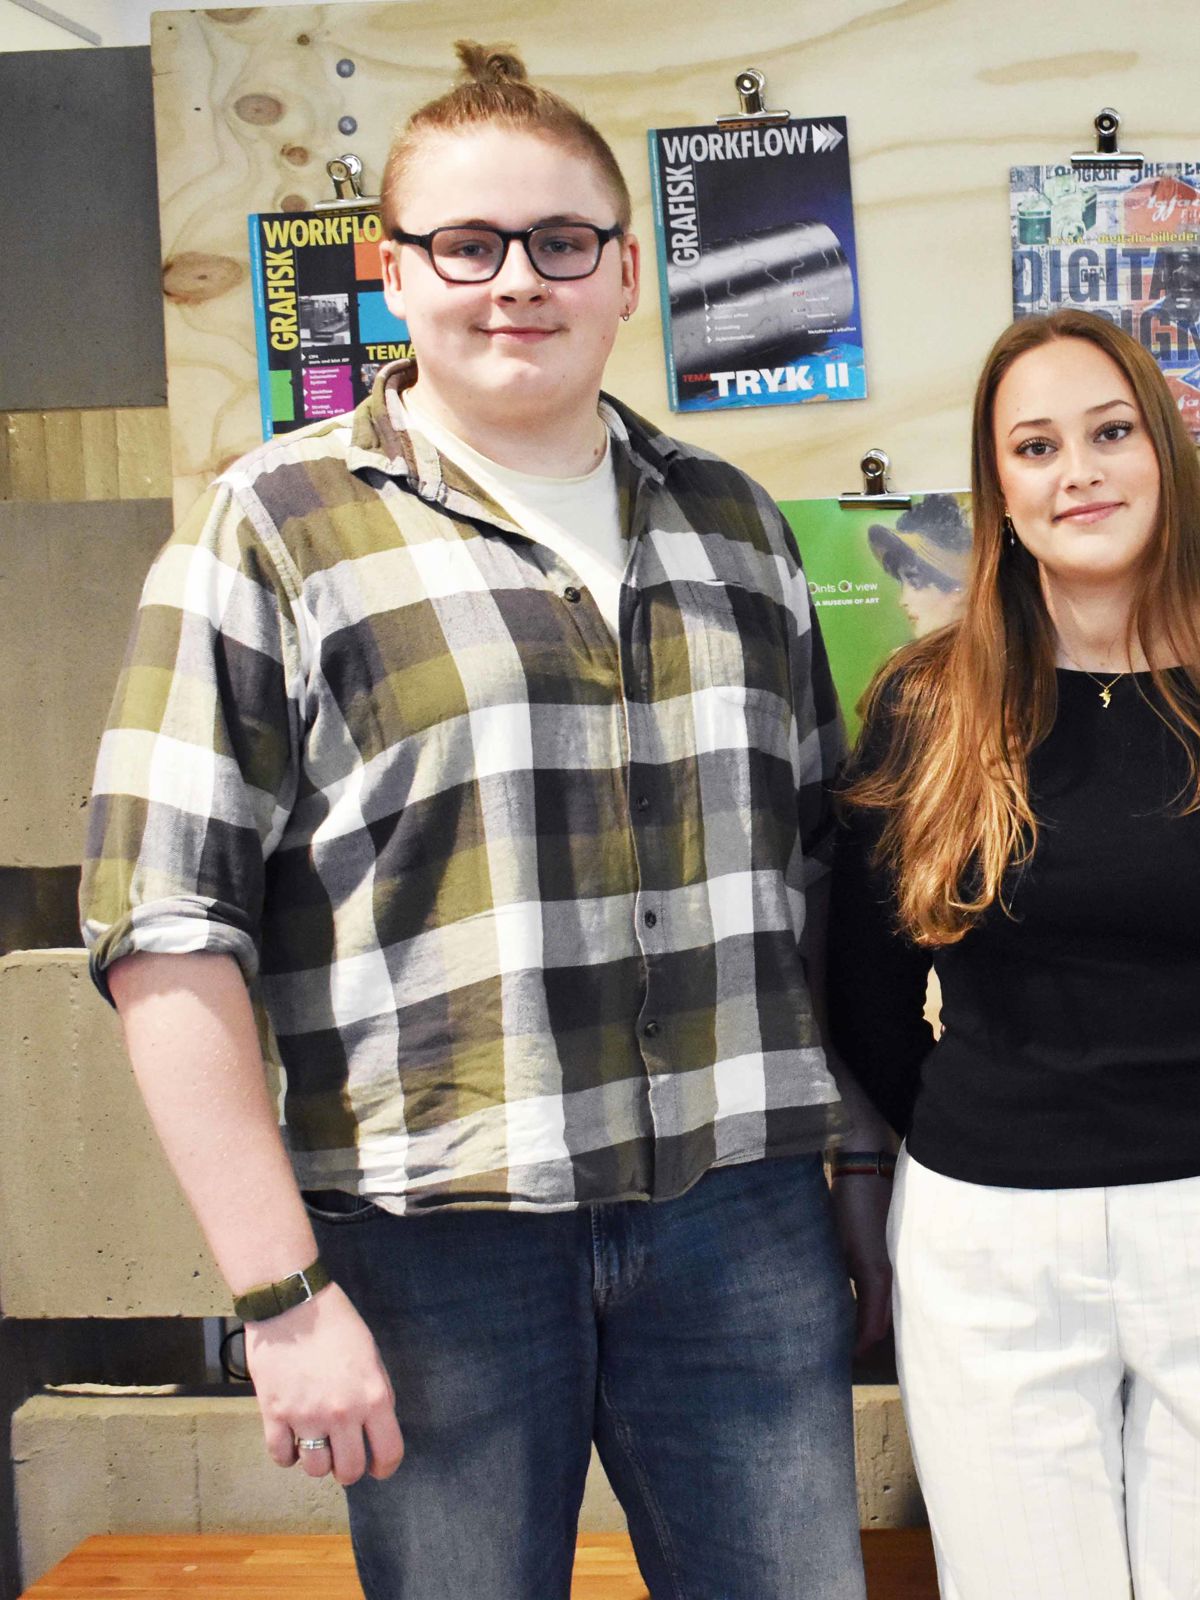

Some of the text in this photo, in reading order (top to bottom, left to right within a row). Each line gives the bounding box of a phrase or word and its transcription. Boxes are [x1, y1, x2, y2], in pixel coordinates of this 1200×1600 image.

[663, 126, 808, 164] WORKFLOW
[262, 214, 383, 249] WORKFLO
[665, 164, 701, 268] GRAFISK
[265, 248, 300, 351] GRAFISK
[709, 365, 814, 397] TRYK
[825, 362, 849, 389] II
